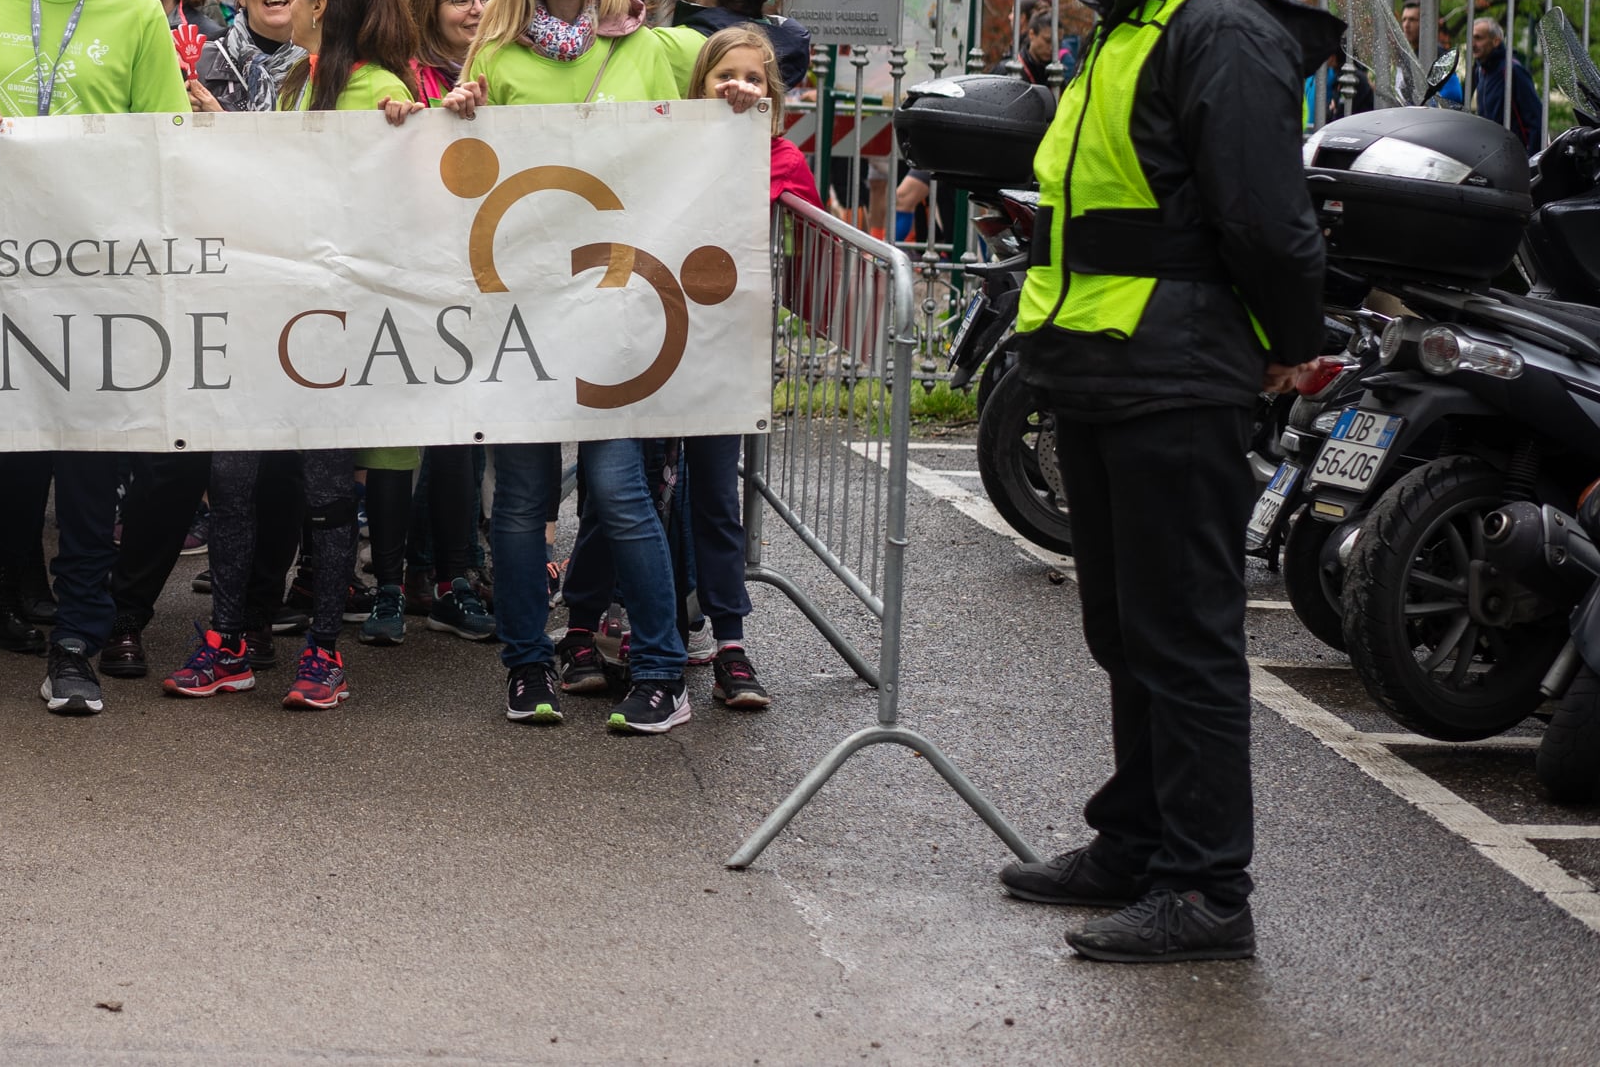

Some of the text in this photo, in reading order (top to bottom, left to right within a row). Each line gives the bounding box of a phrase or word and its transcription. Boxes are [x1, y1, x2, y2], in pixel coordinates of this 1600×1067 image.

[278, 304, 558, 390] CASA
[1345, 413, 1376, 442] DB
[1316, 447, 1379, 483] 56406
